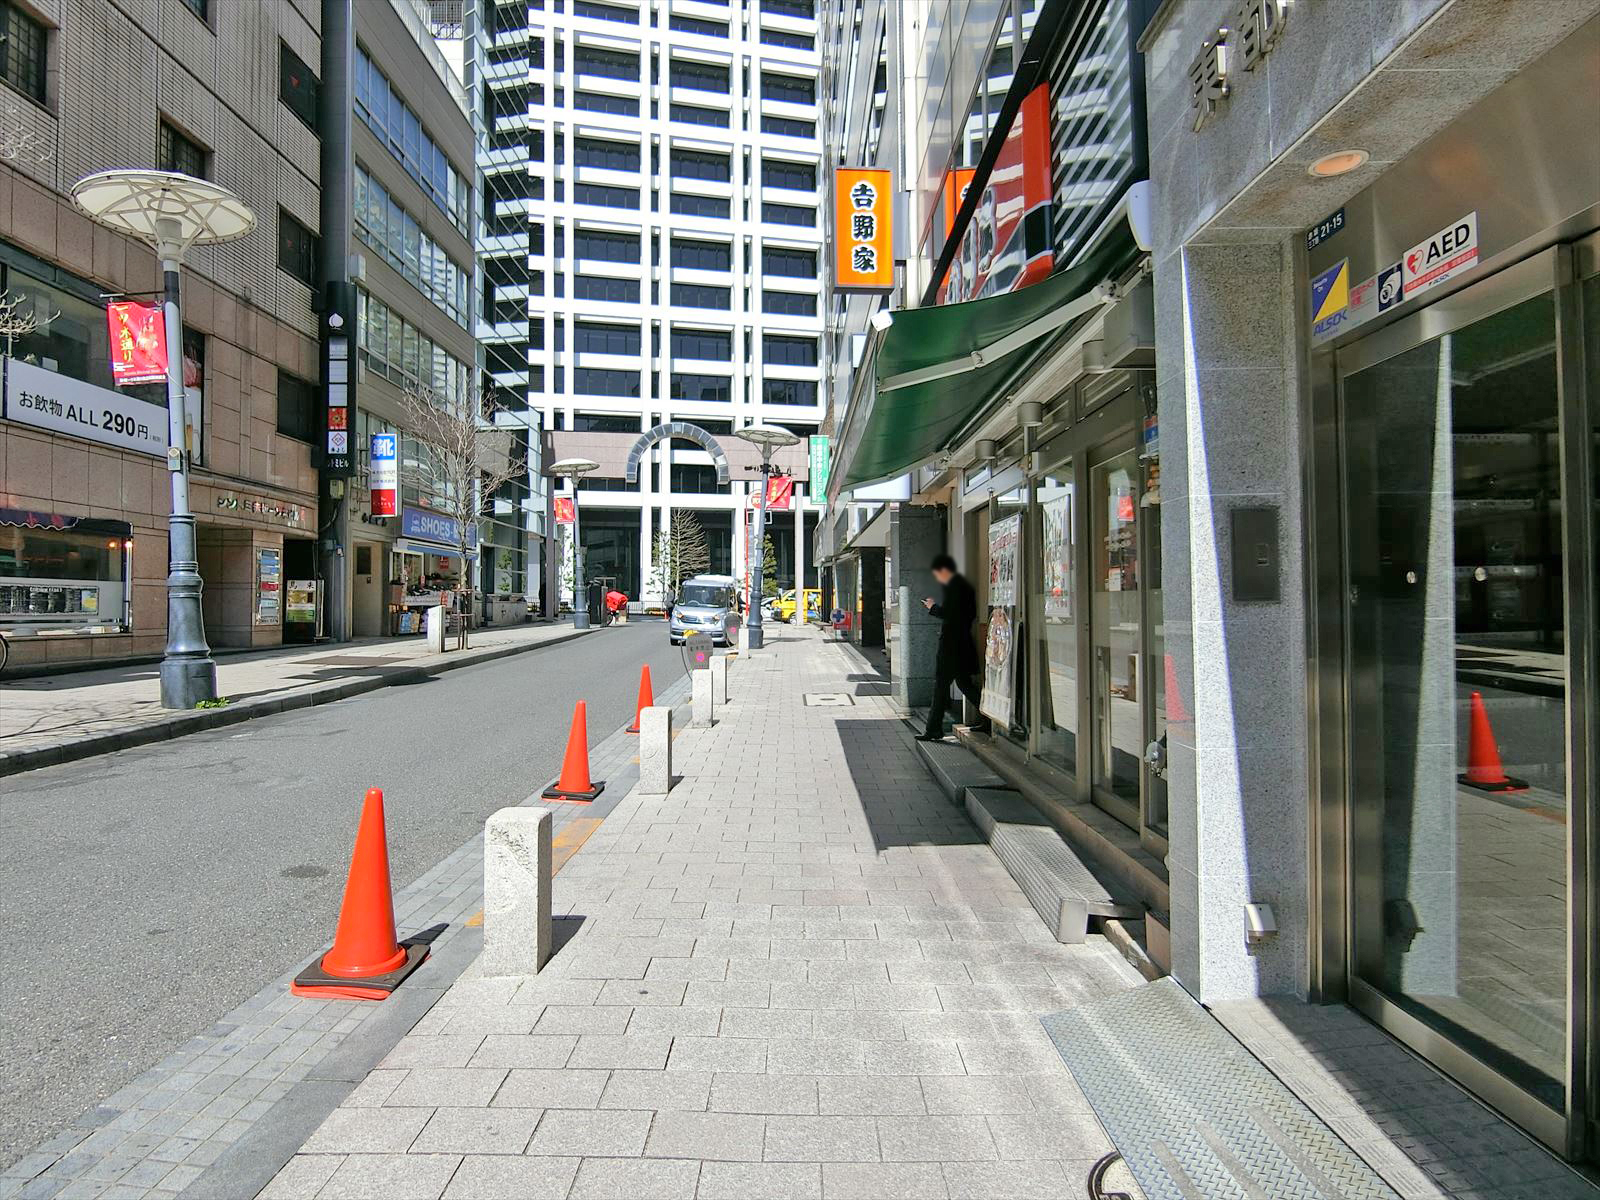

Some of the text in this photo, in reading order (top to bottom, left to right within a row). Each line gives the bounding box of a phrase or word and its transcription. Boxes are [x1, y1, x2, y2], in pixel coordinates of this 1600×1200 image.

[850, 182, 877, 273] 吉野家
[1320, 213, 1342, 238] 21-15
[1426, 223, 1470, 265] AED
[1313, 309, 1348, 336] ALSOK
[19, 390, 63, 417] お飲物
[66, 404, 99, 427] ALL
[372, 438, 395, 457] 靴
[420, 516, 451, 538] SHOES
